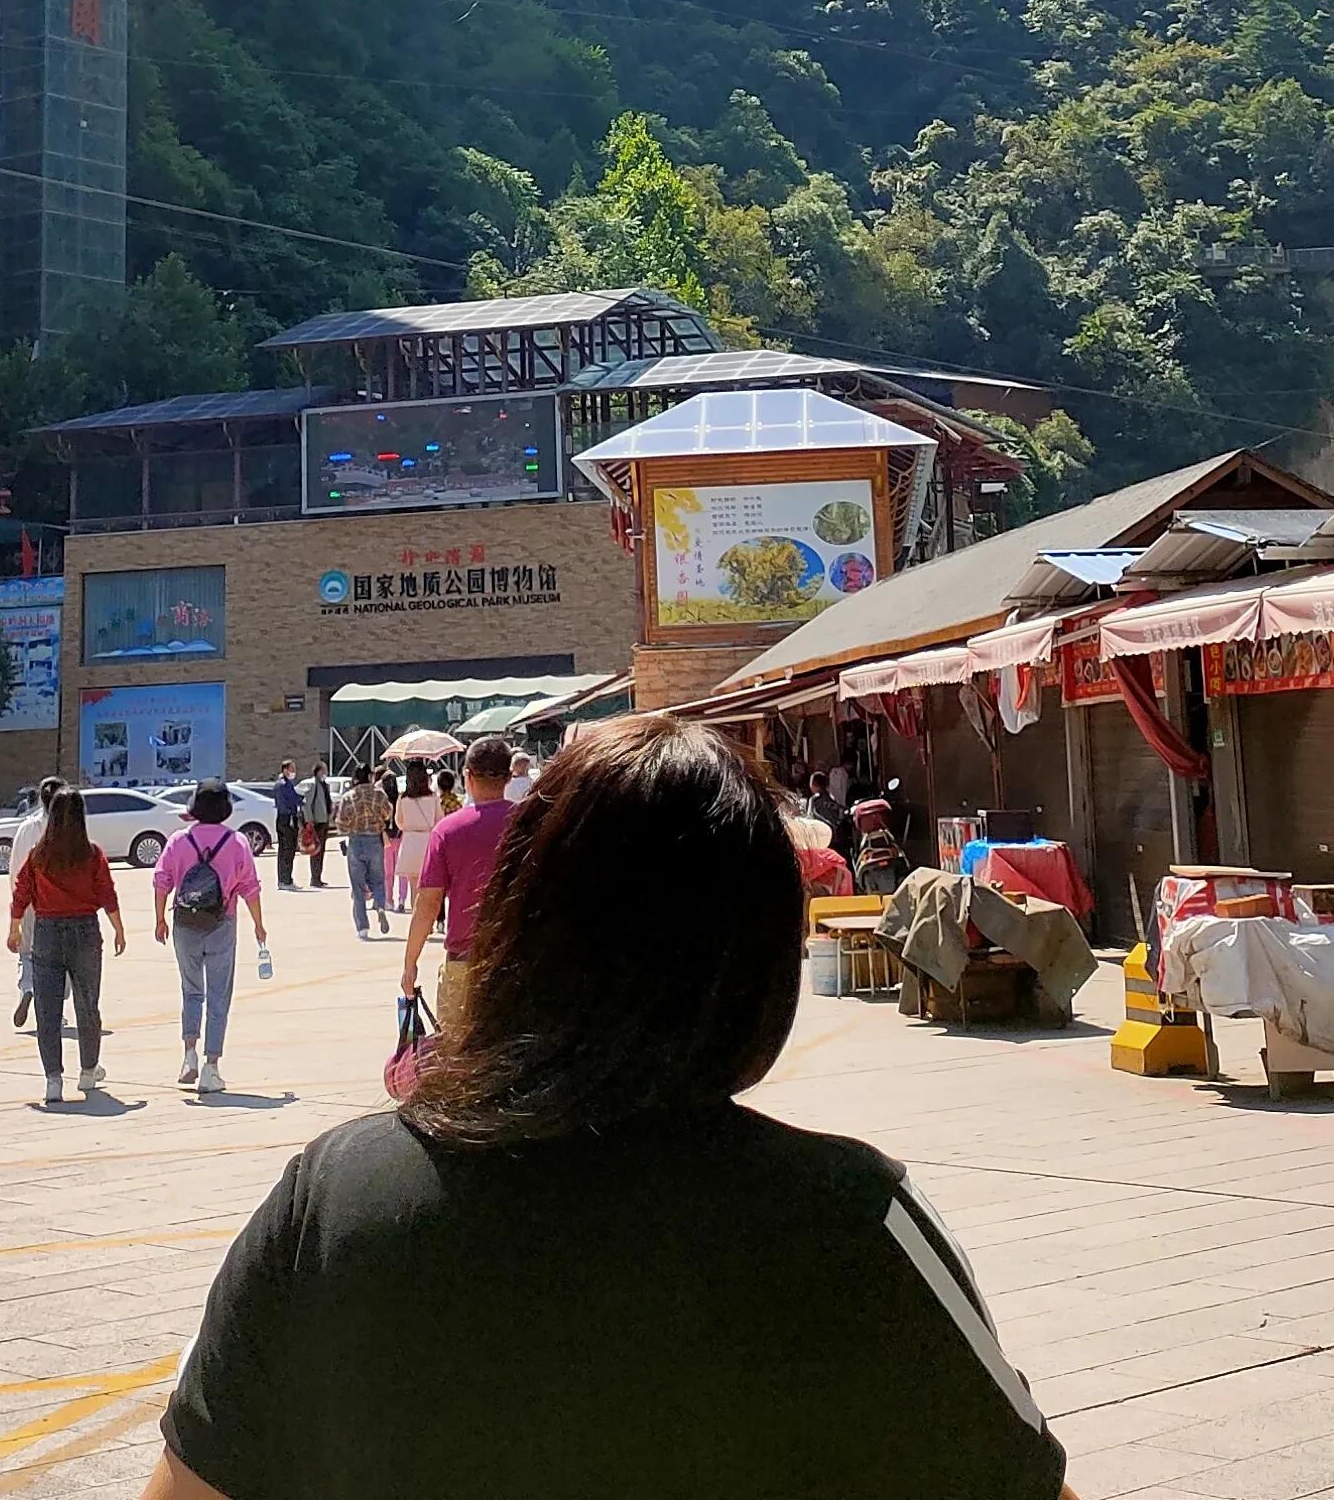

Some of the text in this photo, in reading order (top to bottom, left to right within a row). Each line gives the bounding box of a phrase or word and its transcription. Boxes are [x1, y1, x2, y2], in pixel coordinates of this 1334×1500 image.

[353, 564, 558, 602] 国家地质公园博物馆
[353, 600, 407, 614] NATIONAL
[408, 597, 481, 611] GEOLOGICAL
[481, 595, 512, 607] PARK
[511, 593, 562, 605] MUSEUM
